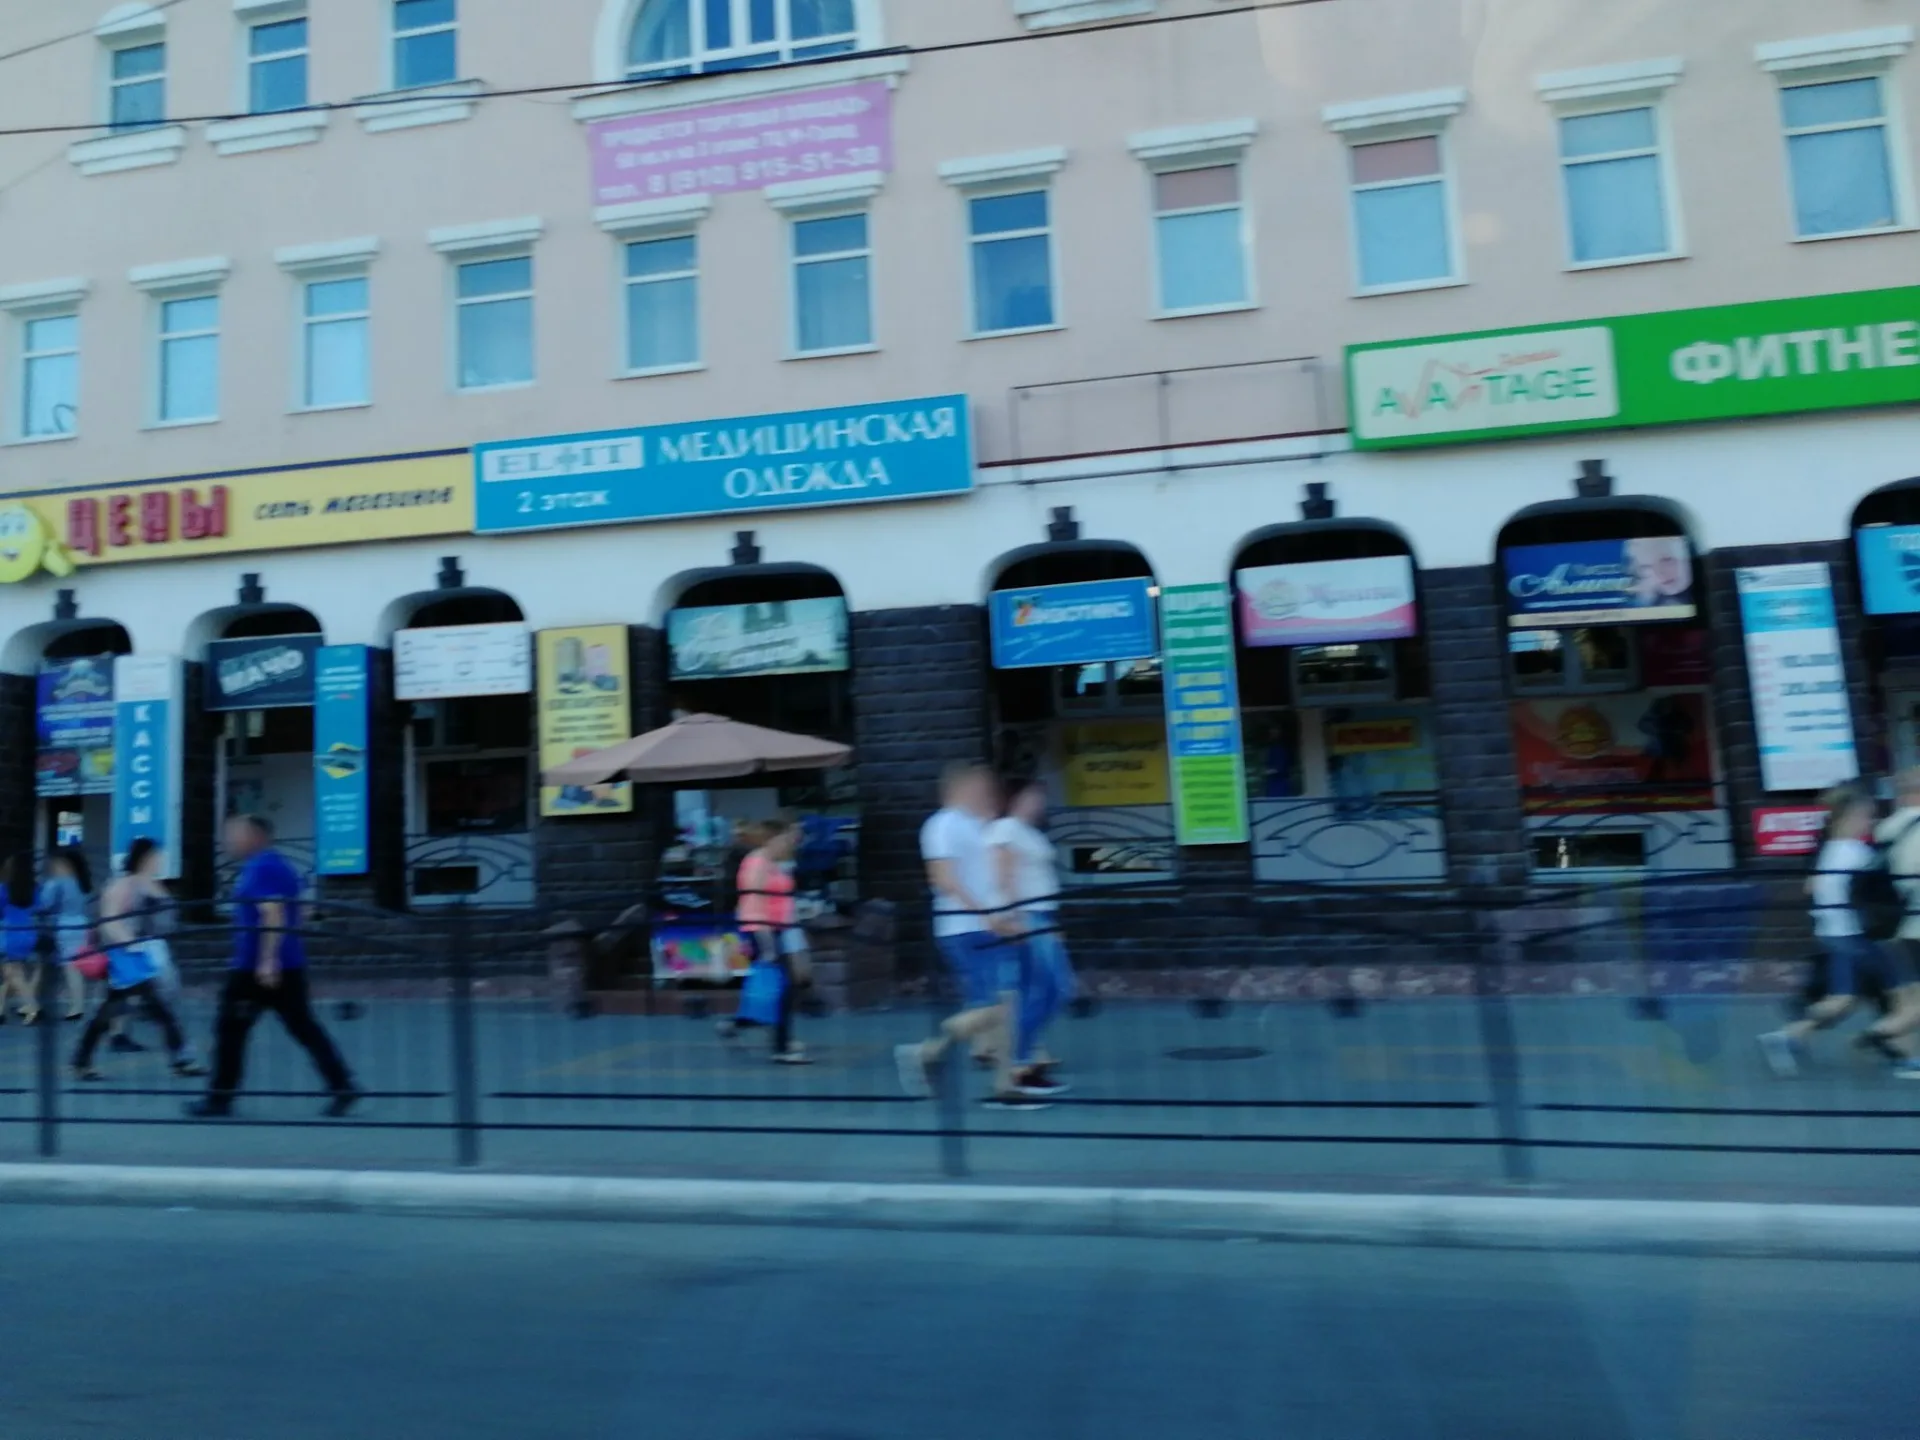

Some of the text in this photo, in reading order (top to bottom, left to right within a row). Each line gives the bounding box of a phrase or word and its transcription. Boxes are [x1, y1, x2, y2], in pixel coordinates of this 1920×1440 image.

[1669, 319, 1920, 385] ФИТНЕ
[656, 406, 956, 466] МЕДИЦИНСКАЯ
[516, 488, 611, 513] 2 этаж
[723, 455, 891, 500] ОДЕЖДА
[67, 484, 229, 557] ЦЕНЫ
